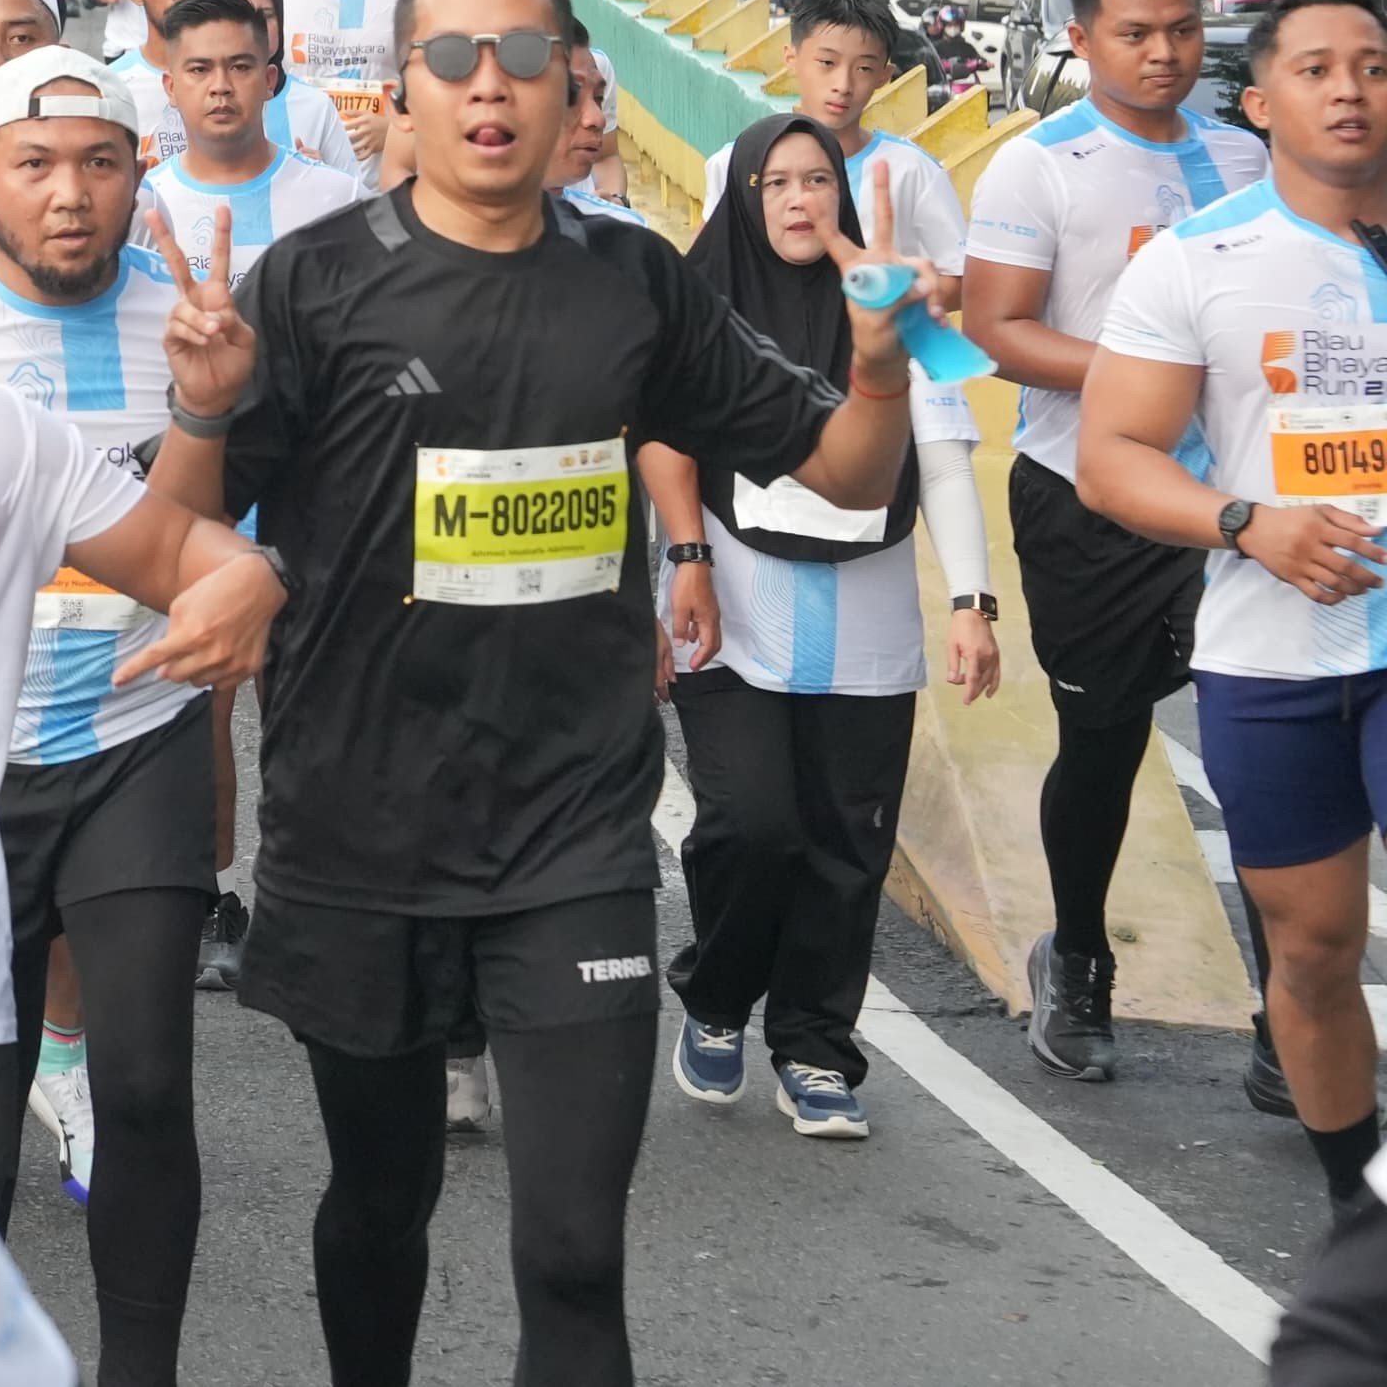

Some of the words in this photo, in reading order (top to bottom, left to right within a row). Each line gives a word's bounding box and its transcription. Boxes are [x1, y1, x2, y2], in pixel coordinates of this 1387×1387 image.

[308, 55, 332, 66] Run
[187, 255, 212, 270] Ria
[1303, 329, 1365, 351] Riau
[1303, 375, 1358, 397] Run
[434, 485, 616, 538] M-8022095
